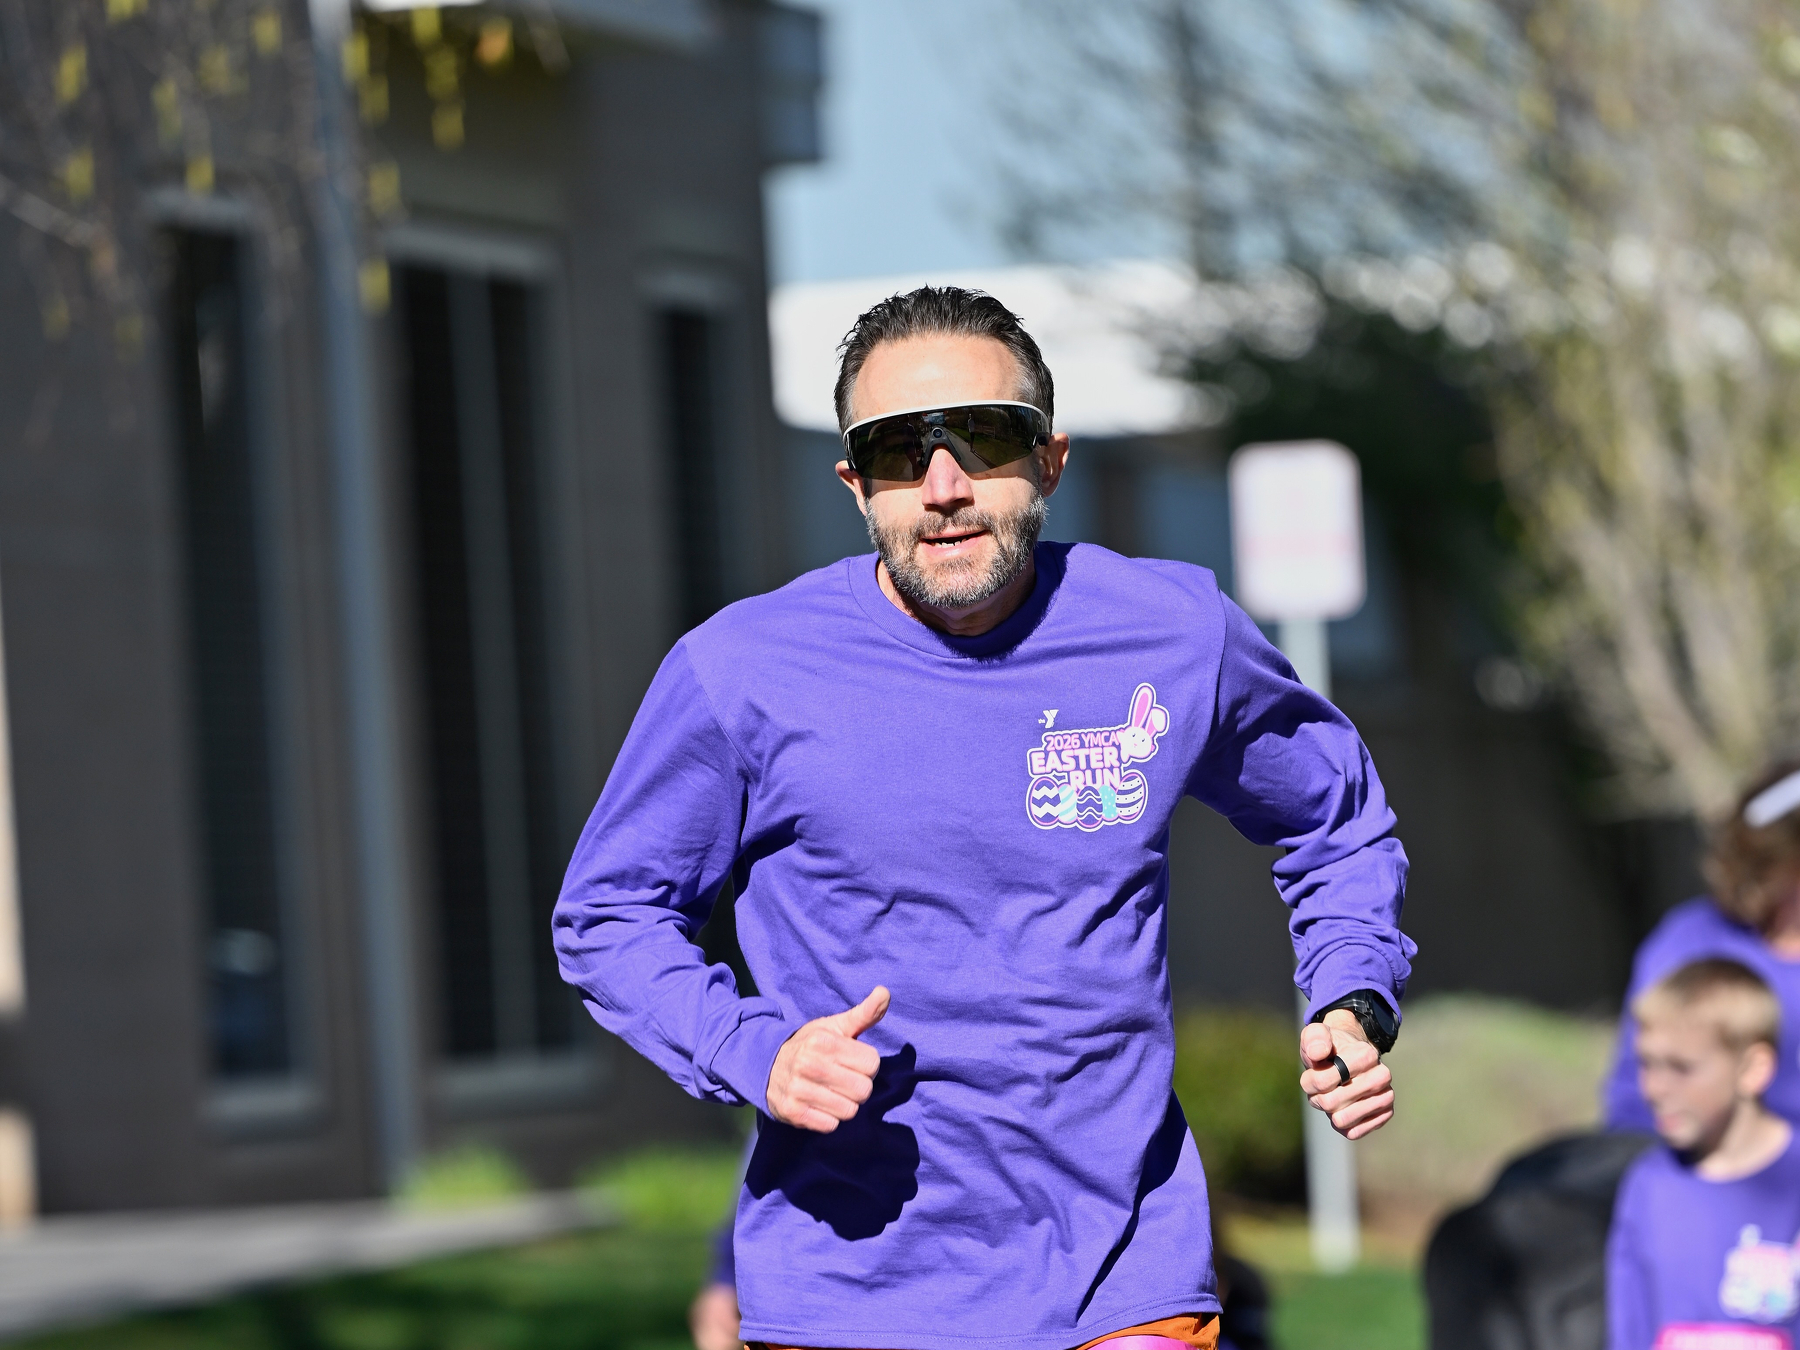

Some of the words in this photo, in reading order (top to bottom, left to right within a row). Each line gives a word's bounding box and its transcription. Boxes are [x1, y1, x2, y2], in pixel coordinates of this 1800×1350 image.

[1046, 734, 1080, 751] 2026
[1081, 731, 1120, 748] YMCA
[1031, 746, 1120, 774] EASTER
[1069, 768, 1121, 791] RUN
